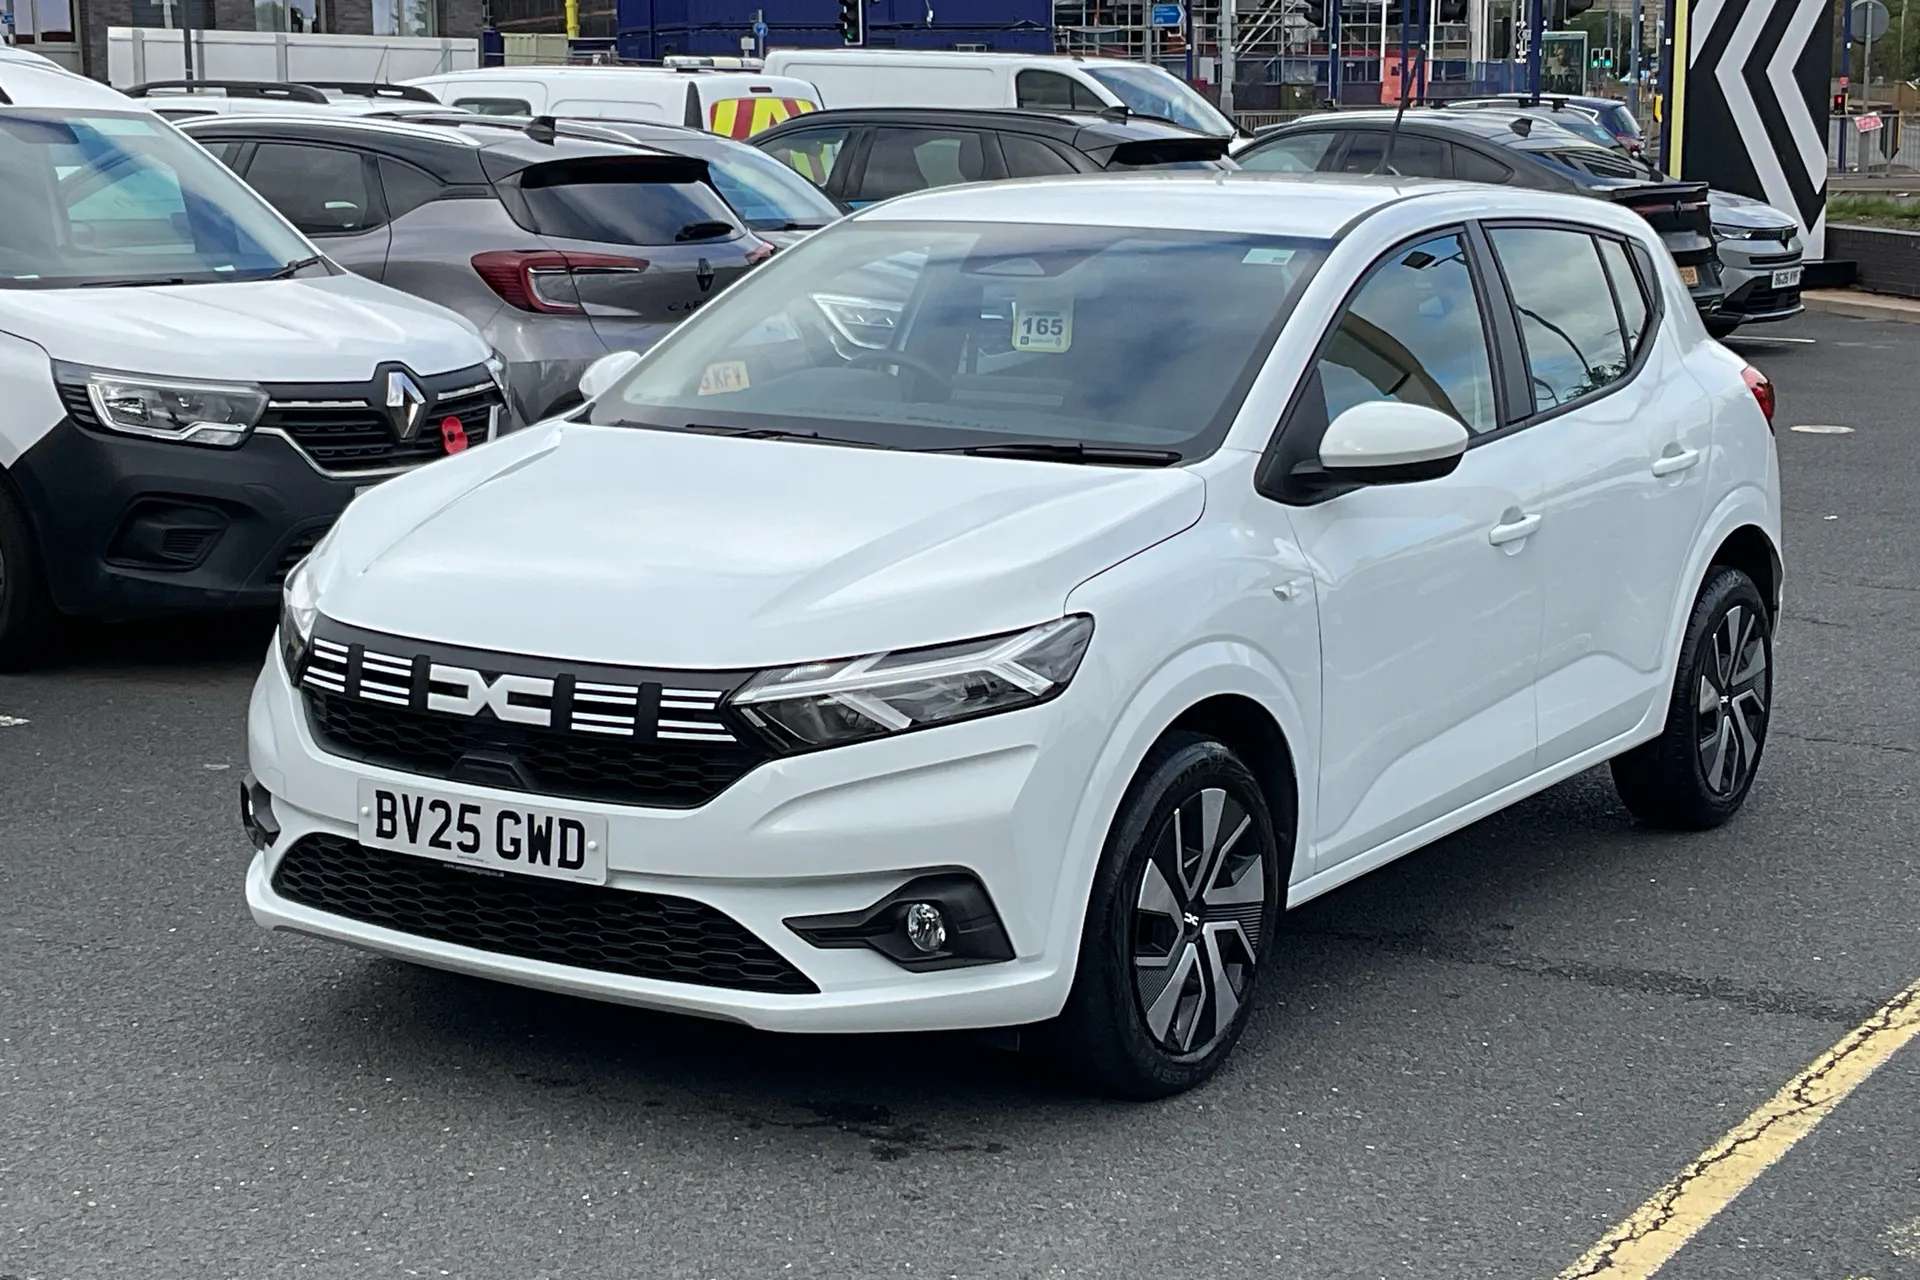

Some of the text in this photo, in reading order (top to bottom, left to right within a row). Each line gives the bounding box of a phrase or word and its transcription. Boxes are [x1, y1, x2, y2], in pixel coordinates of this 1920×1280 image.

[1022, 317, 1064, 336] 165
[375, 789, 586, 870] BV25 GWD
